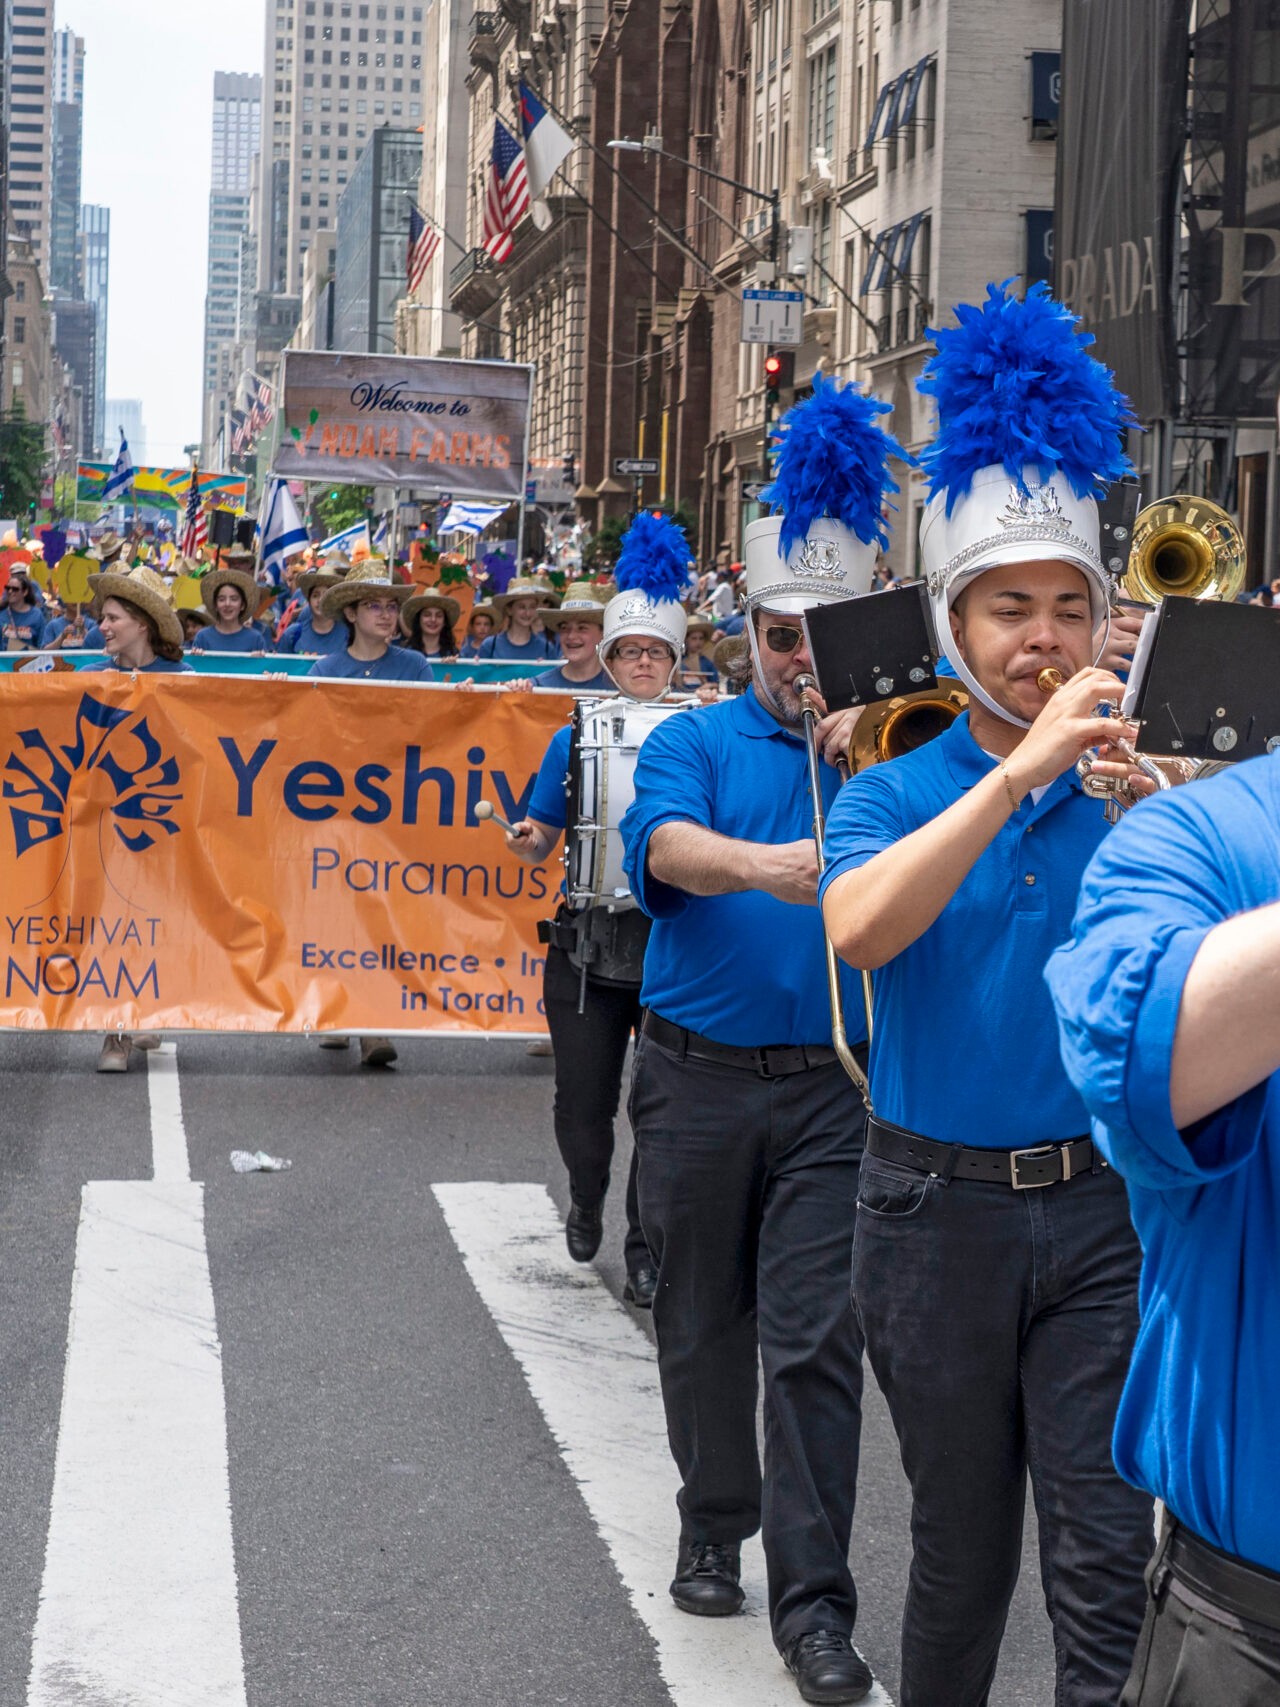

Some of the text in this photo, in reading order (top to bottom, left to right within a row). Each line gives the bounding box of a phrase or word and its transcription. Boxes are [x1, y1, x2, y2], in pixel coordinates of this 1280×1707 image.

[1060, 236, 1157, 325] PRADA
[350, 381, 472, 417] Welcome to
[317, 423, 512, 469] NOAM FARMS
[218, 737, 539, 828] Yeshiv
[311, 848, 561, 904] Paramus,
[5, 915, 161, 947] YESHIVAT
[5, 953, 160, 999] NOAM
[301, 942, 480, 974] Excellence
[401, 984, 428, 1011] in
[438, 986, 525, 1015] Torah
